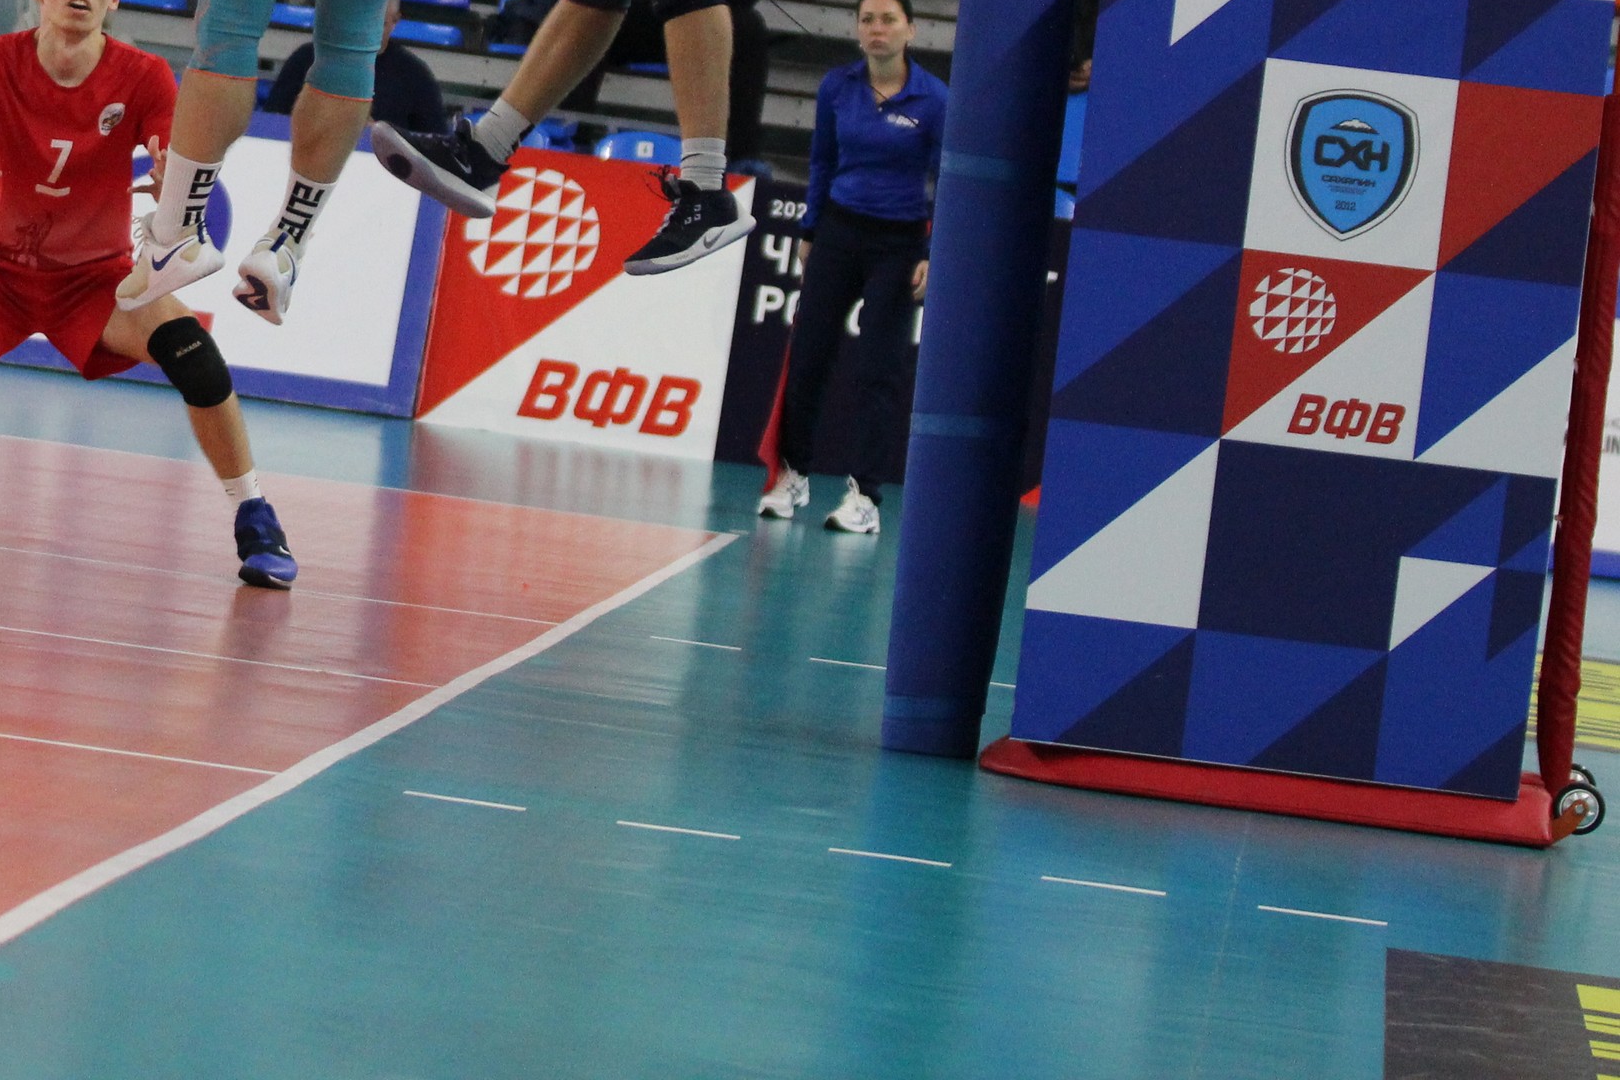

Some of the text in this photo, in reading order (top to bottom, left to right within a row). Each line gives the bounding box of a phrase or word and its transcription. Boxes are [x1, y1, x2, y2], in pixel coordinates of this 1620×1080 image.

[47, 139, 73, 184] 7
[516, 358, 703, 438] ВФВ
[1286, 393, 1407, 445] ВФВ
